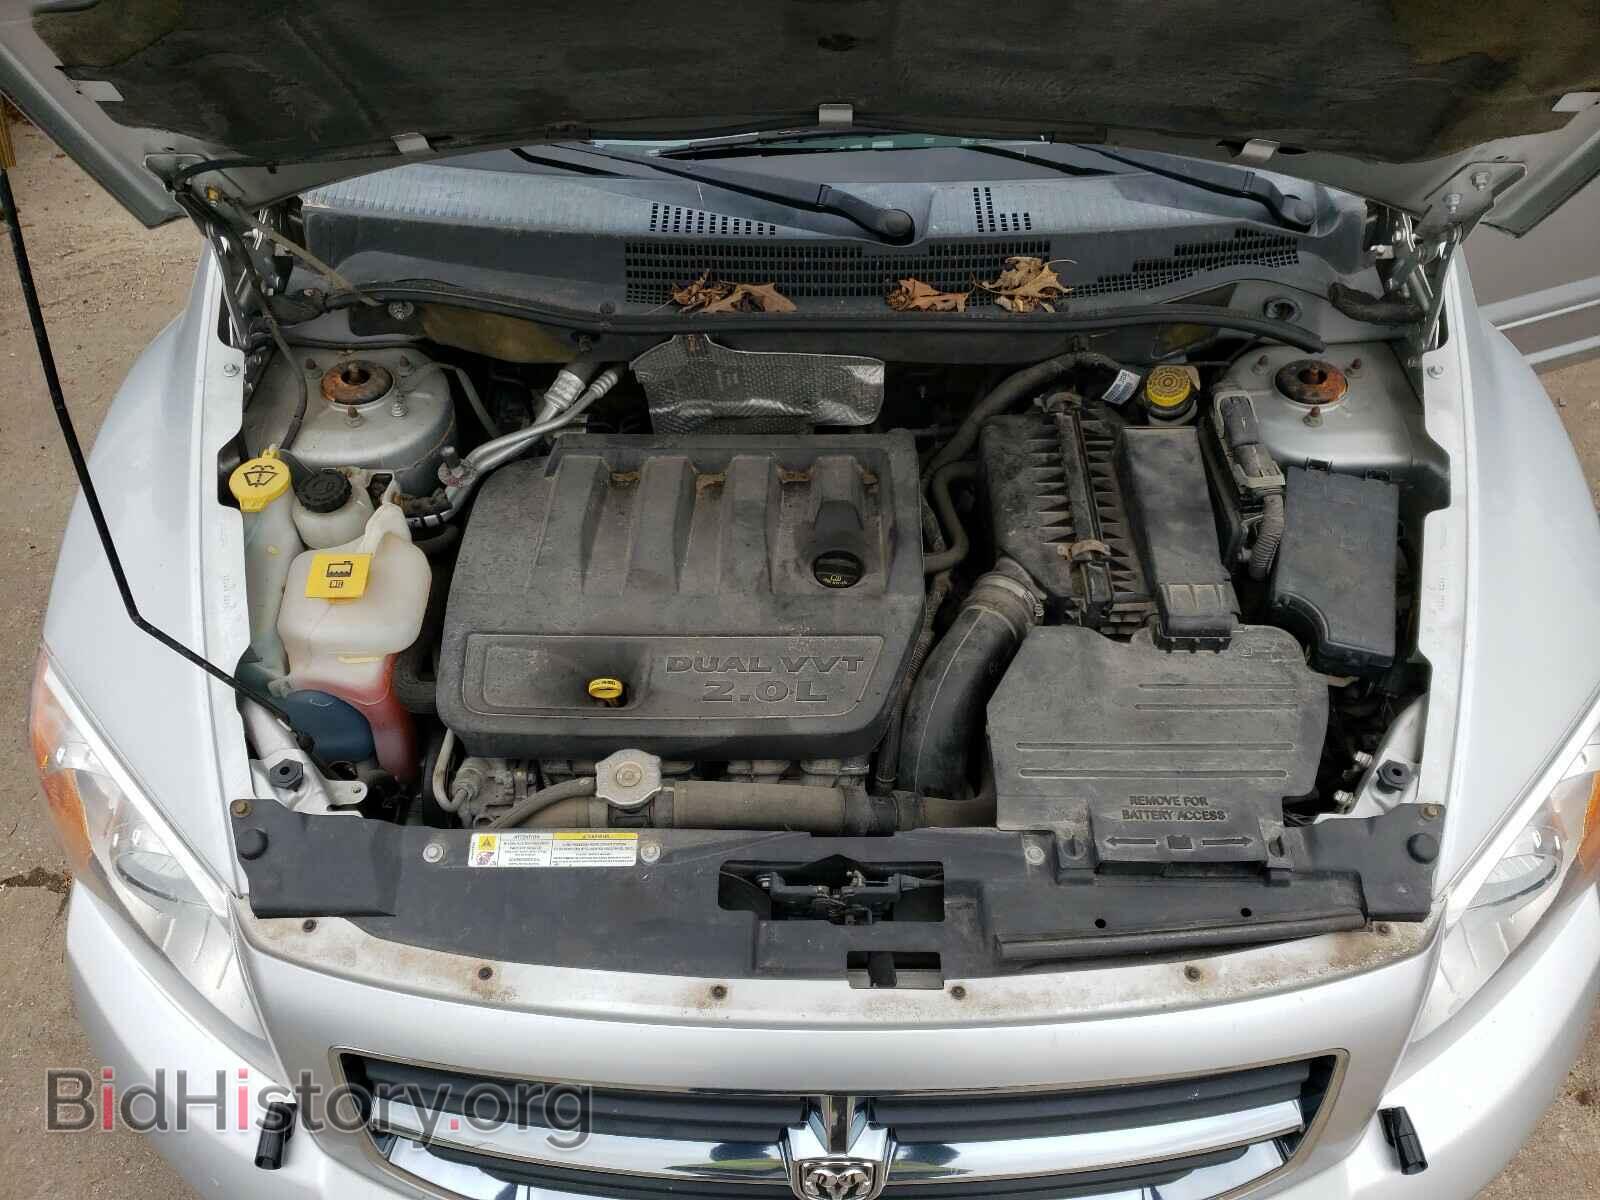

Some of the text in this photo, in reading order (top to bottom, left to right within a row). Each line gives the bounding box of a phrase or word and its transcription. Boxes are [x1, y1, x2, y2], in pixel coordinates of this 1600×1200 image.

[665, 656, 865, 674] DUAL VVT
[702, 680, 828, 703] 2.0L
[1128, 795, 1209, 807] REMOVE FOR
[1121, 809, 1227, 821] BATTERY ACCESS
